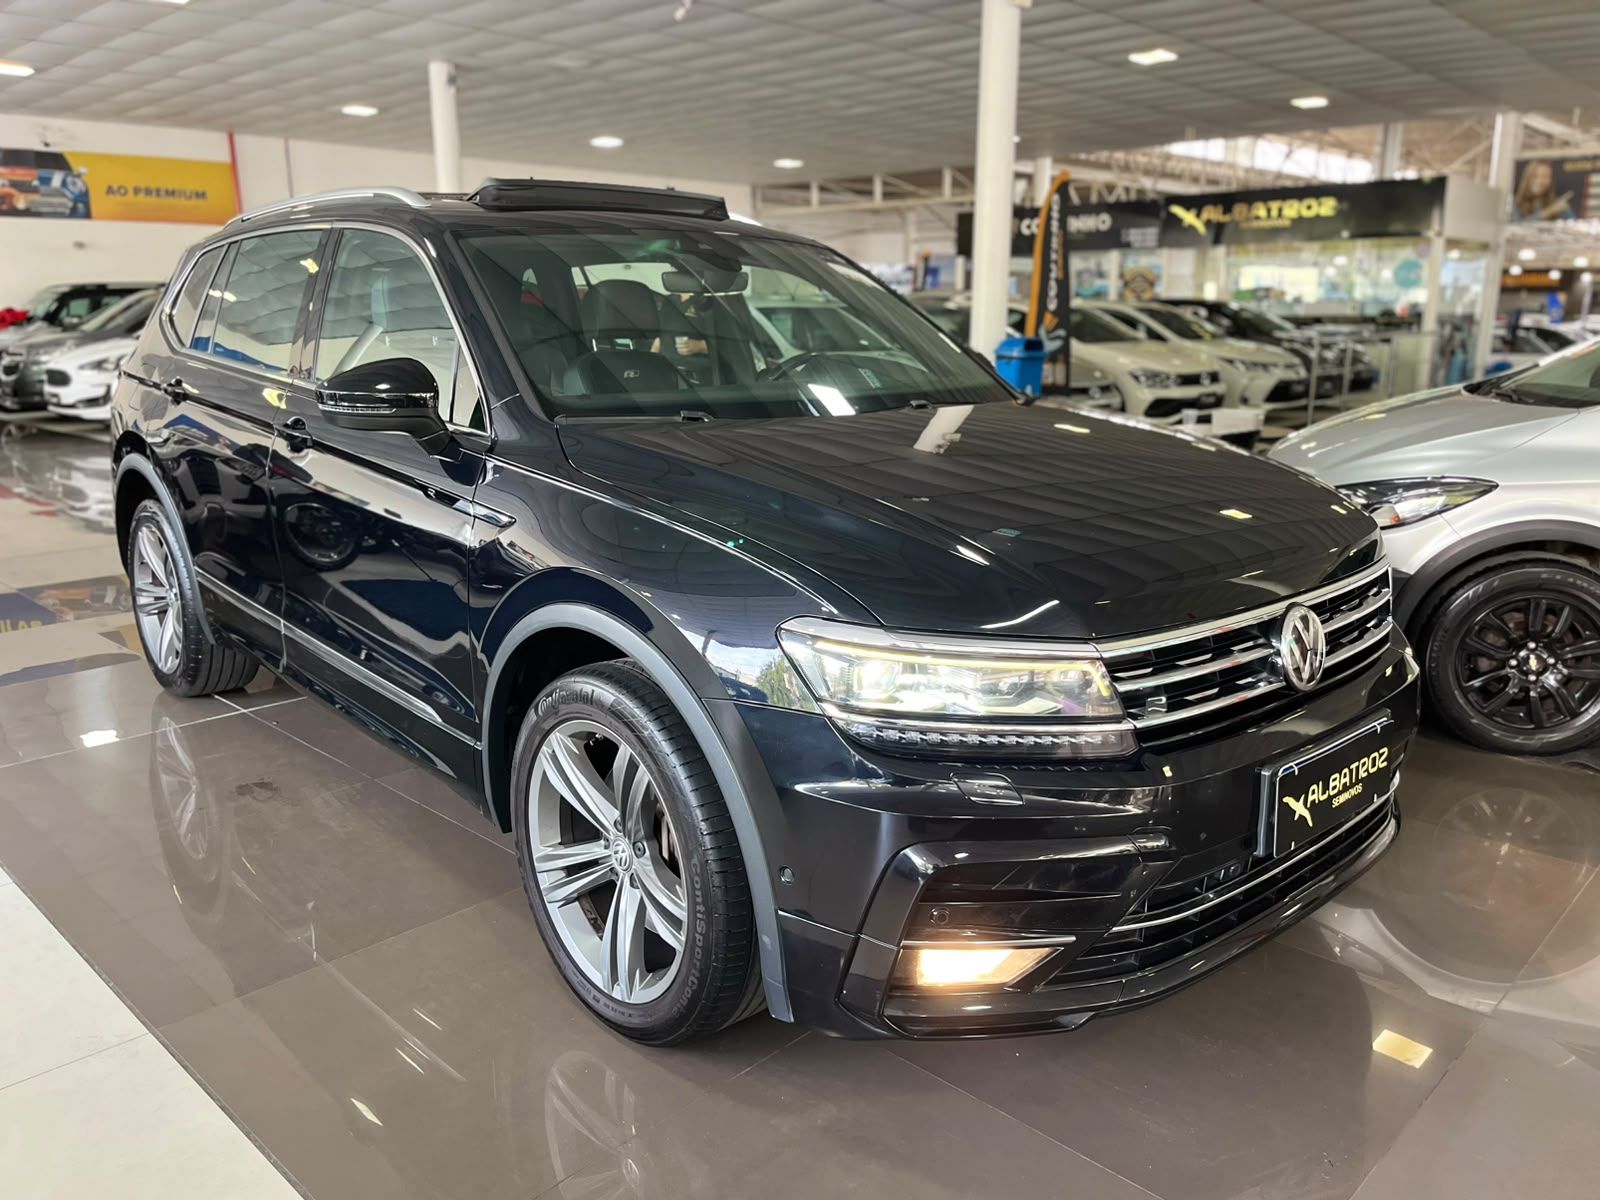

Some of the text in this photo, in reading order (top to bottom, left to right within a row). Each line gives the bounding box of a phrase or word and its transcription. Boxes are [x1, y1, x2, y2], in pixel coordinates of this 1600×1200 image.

[106, 185, 207, 200] AO PREMIUM
[1201, 196, 1338, 223] ALBATROZ
[1306, 746, 1389, 809] ALBATROZ
[1331, 782, 1363, 809] SEMINOVOS
